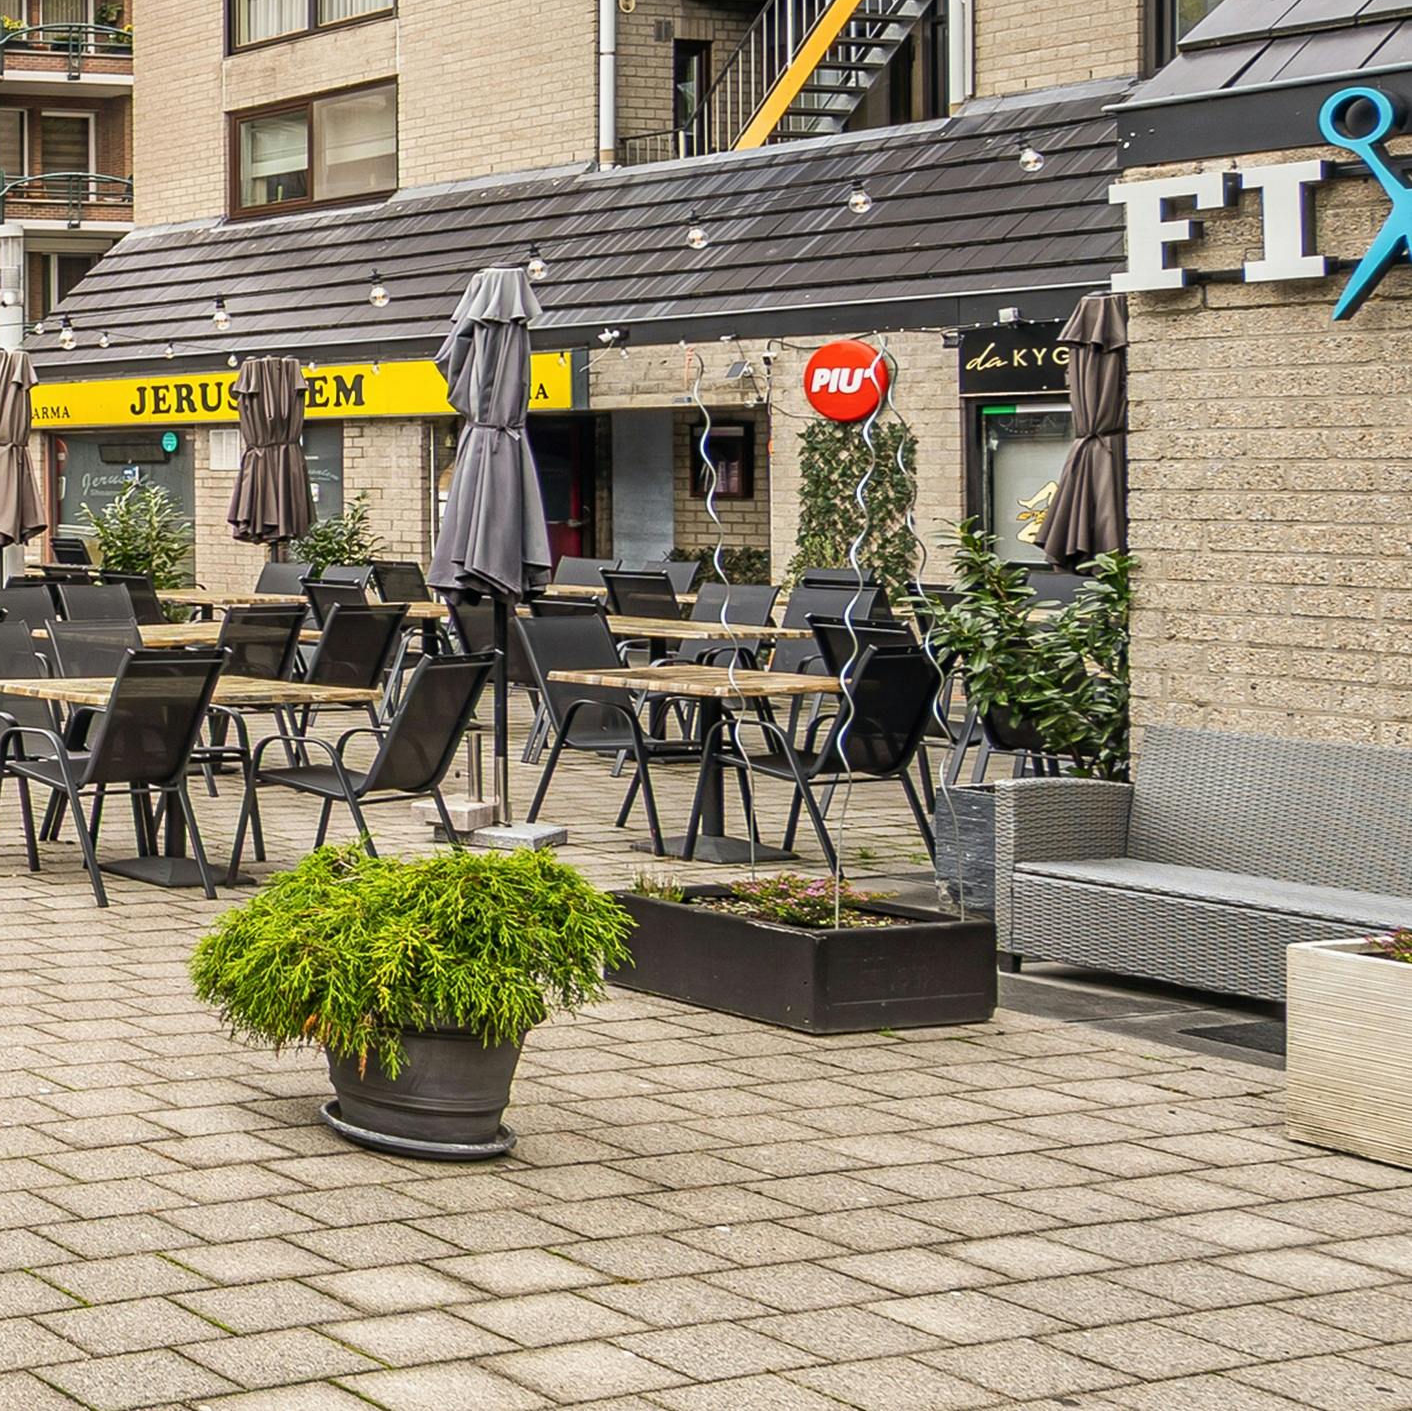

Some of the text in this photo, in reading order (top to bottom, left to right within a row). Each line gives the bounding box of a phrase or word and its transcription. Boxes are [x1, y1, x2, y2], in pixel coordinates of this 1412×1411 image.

[1013, 346, 1071, 367] KYG
[130, 374, 365, 416] JERUSEM
[31, 405, 71, 420] ARMA
